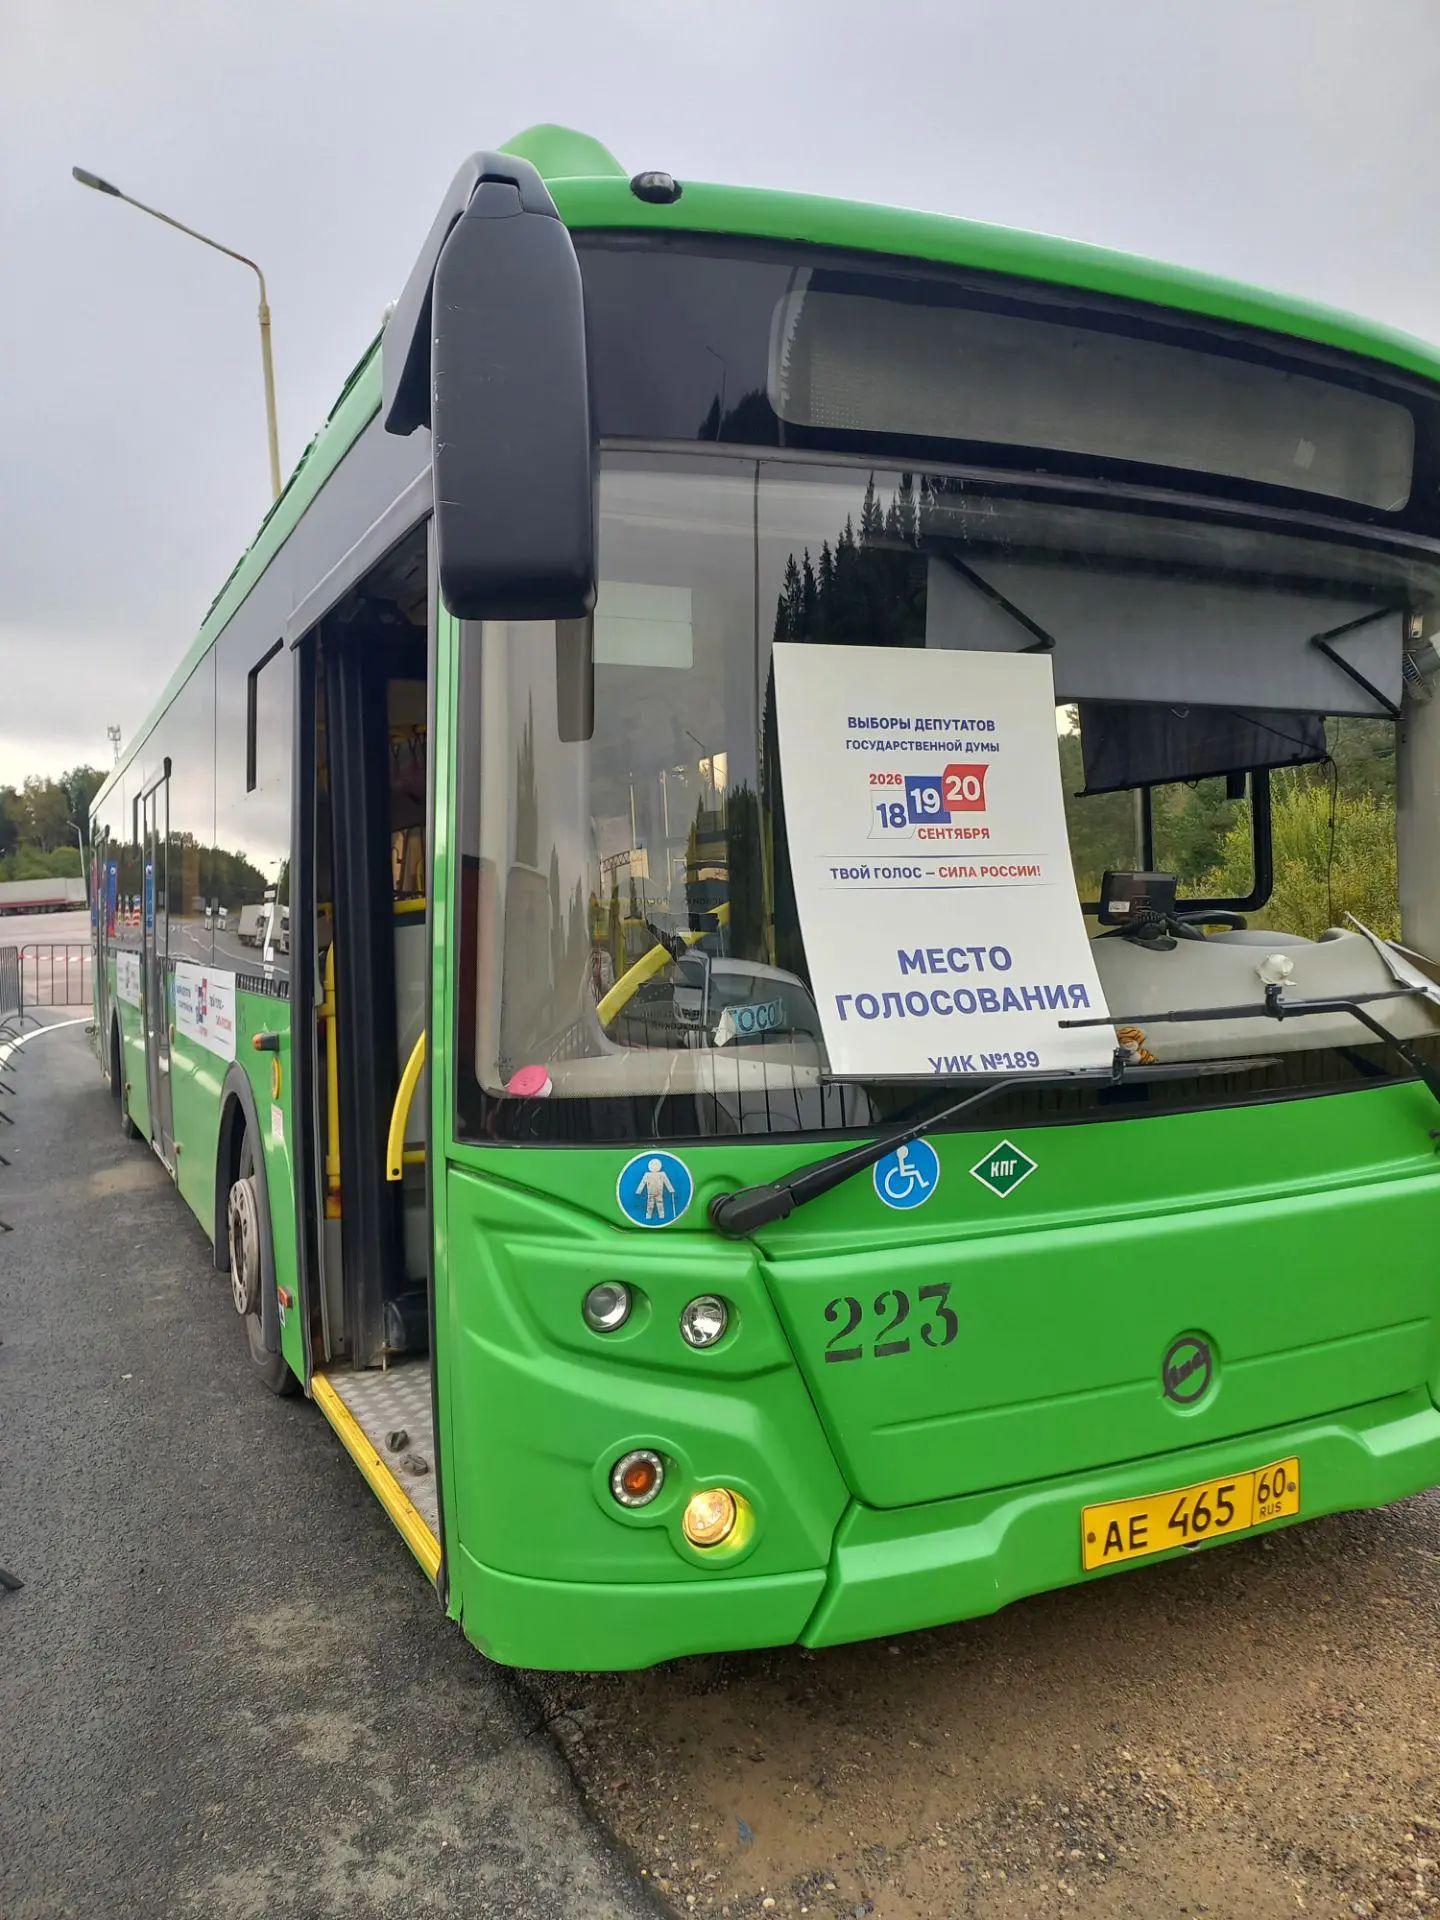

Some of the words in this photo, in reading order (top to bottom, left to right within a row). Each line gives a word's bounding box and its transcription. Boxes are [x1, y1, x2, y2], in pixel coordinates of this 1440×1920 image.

[848, 717, 911, 730] ВЫБОРЫ
[915, 718, 996, 732] ДЕПУТАТОВ
[846, 739, 963, 752] ГОСУДАРСТВЕННОЙ
[965, 742, 1000, 753] ДУМЫ
[869, 773, 903, 785] 2026
[876, 803, 907, 828] 18
[910, 788, 941, 814] 19
[945, 775, 981, 801] 20
[918, 828, 990, 840] СЕНТЯБРЯ
[830, 864, 871, 880] ТВОЙ
[873, 867, 922, 879] ГОЛОС
[938, 865, 977, 878] СИЛА
[981, 865, 1041, 878] РОССИИ!
[897, 946, 1012, 975] МЕСТО
[835, 984, 1091, 1021] ГОЛОСОВАНИЯ
[928, 1054, 977, 1074] УИК
[980, 1051, 1040, 1071] №189
[990, 1159, 1018, 1178] КПГ
[824, 1282, 959, 1364] 223
[1257, 1467, 1286, 1504] 60
[1103, 1513, 1149, 1556] АЕ
[1168, 1484, 1236, 1537] 465
[1259, 1501, 1282, 1518] RUS
